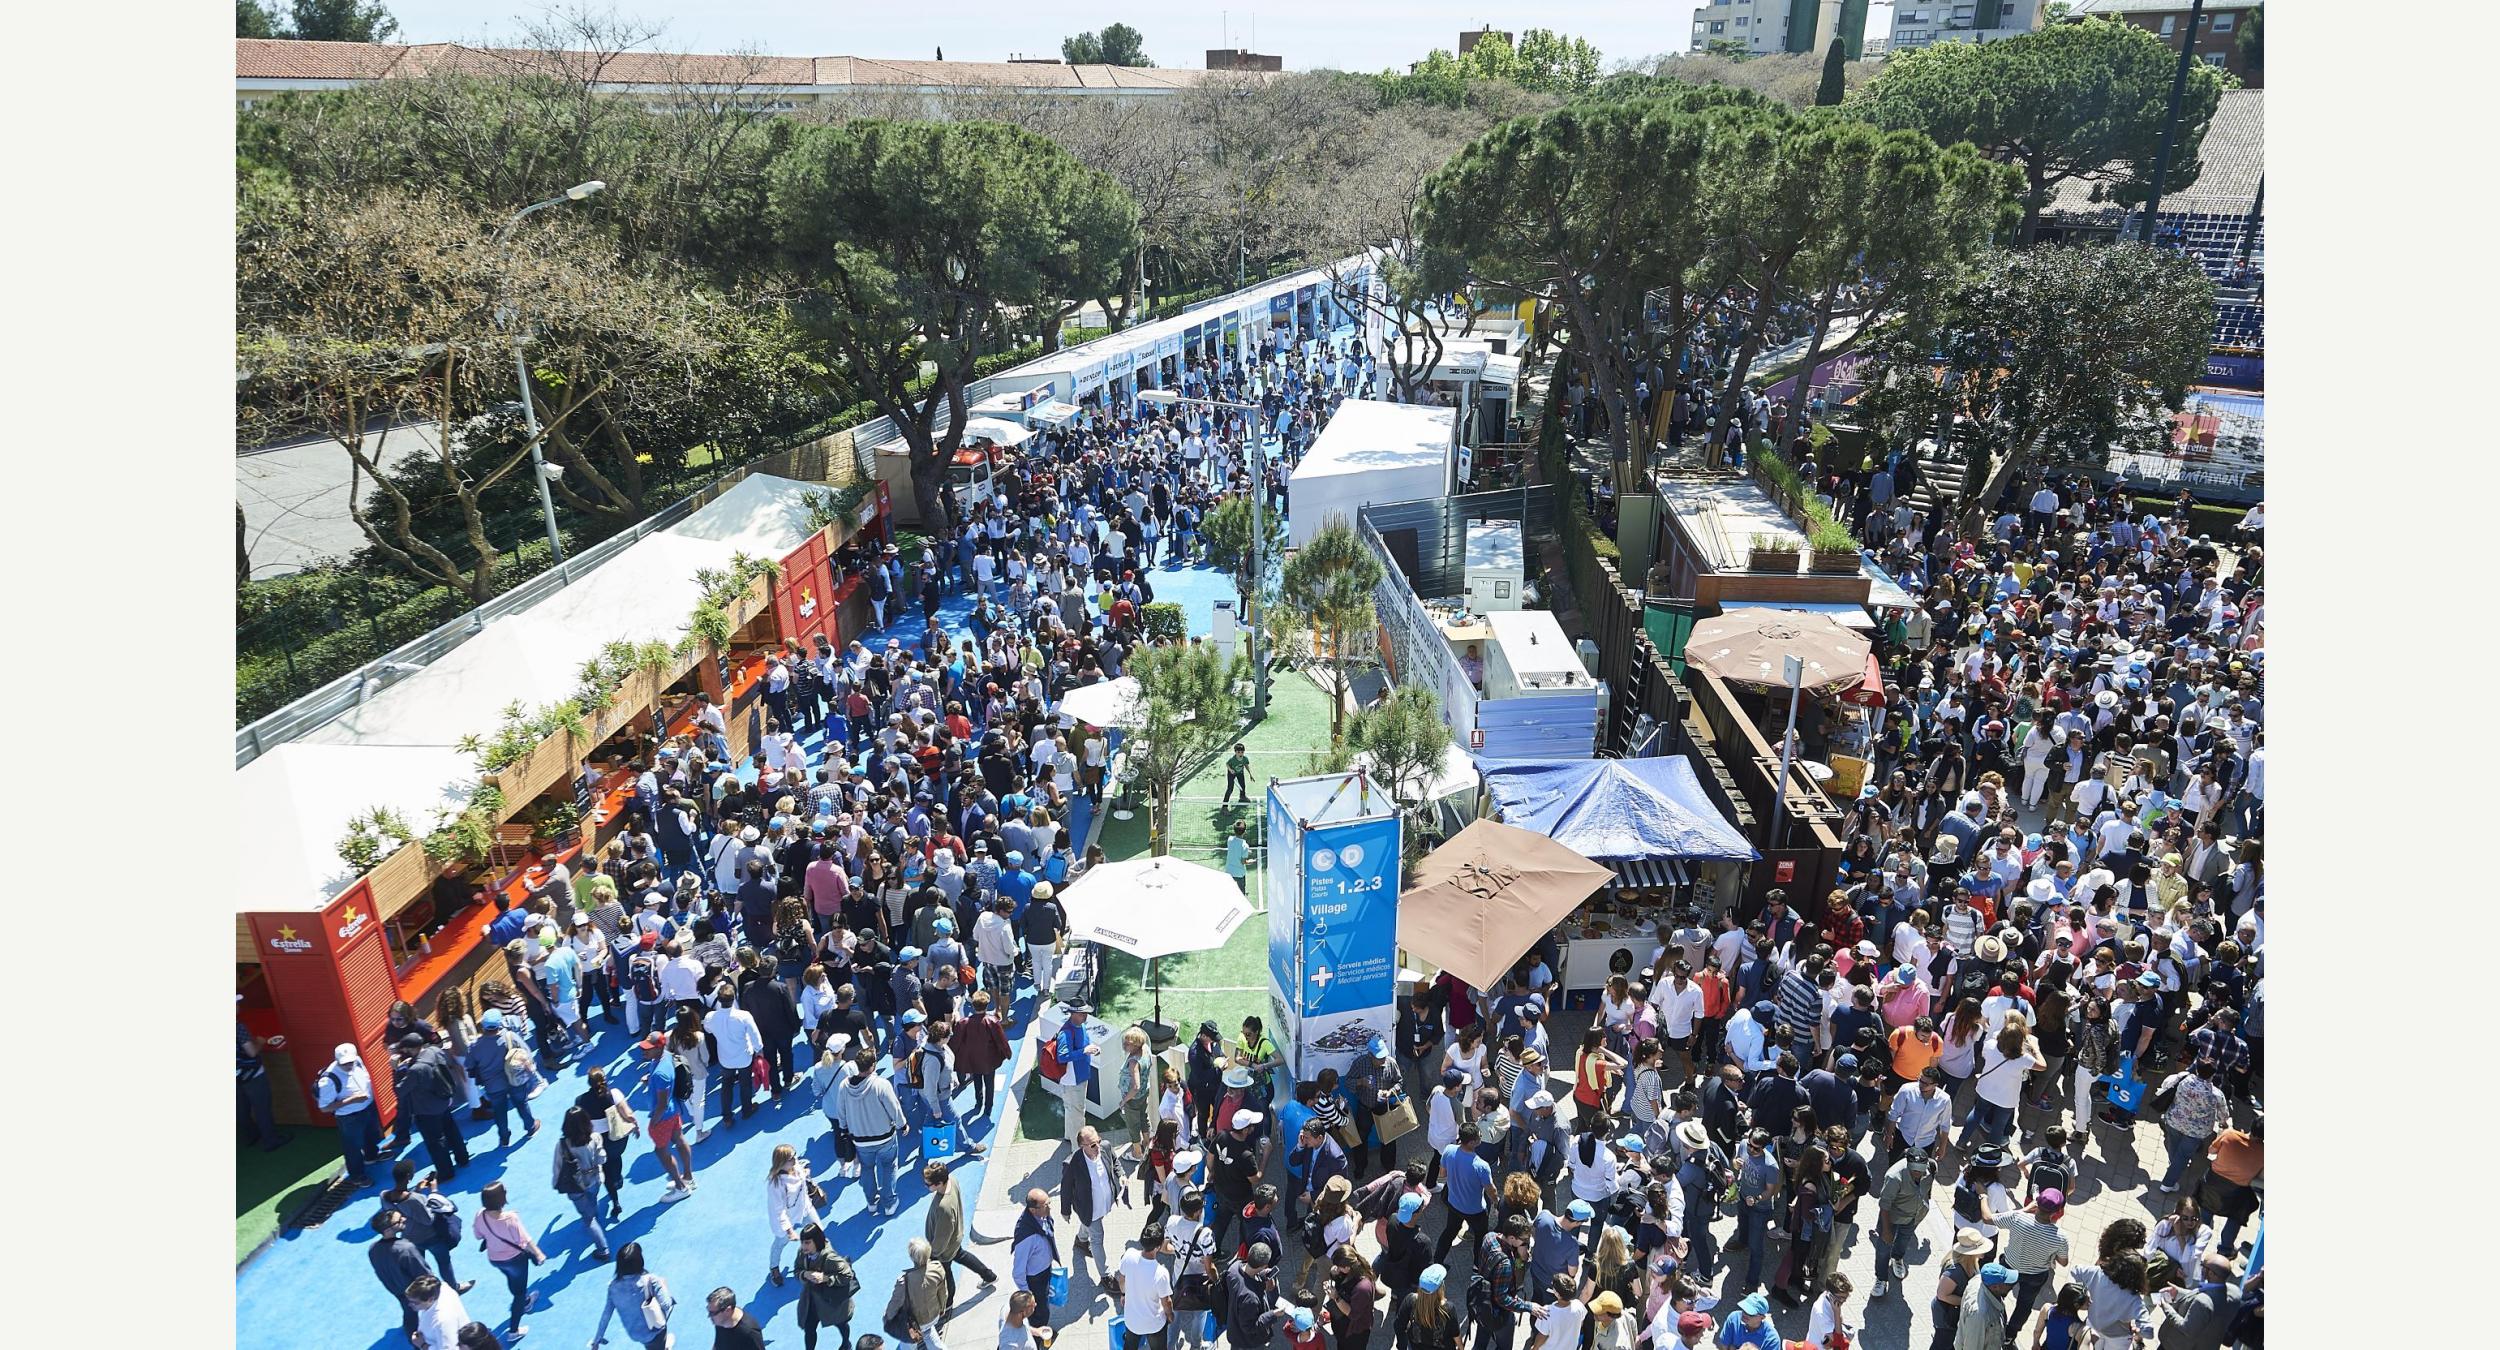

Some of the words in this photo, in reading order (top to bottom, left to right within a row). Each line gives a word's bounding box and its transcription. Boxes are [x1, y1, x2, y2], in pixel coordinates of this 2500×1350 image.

[1113, 359, 1130, 371] DUNLOP
[1082, 370, 1102, 383] DUNLOP
[1311, 878, 1334, 886] Pistes
[1337, 875, 1382, 895] 1.2.3
[1311, 903, 1347, 915] Village
[271, 938, 312, 949] Estrella
[1337, 968, 1365, 977] Servicios
[1337, 974, 1361, 984] Medical
[1362, 972, 1387, 981] services
[938, 1138, 949, 1151] S
